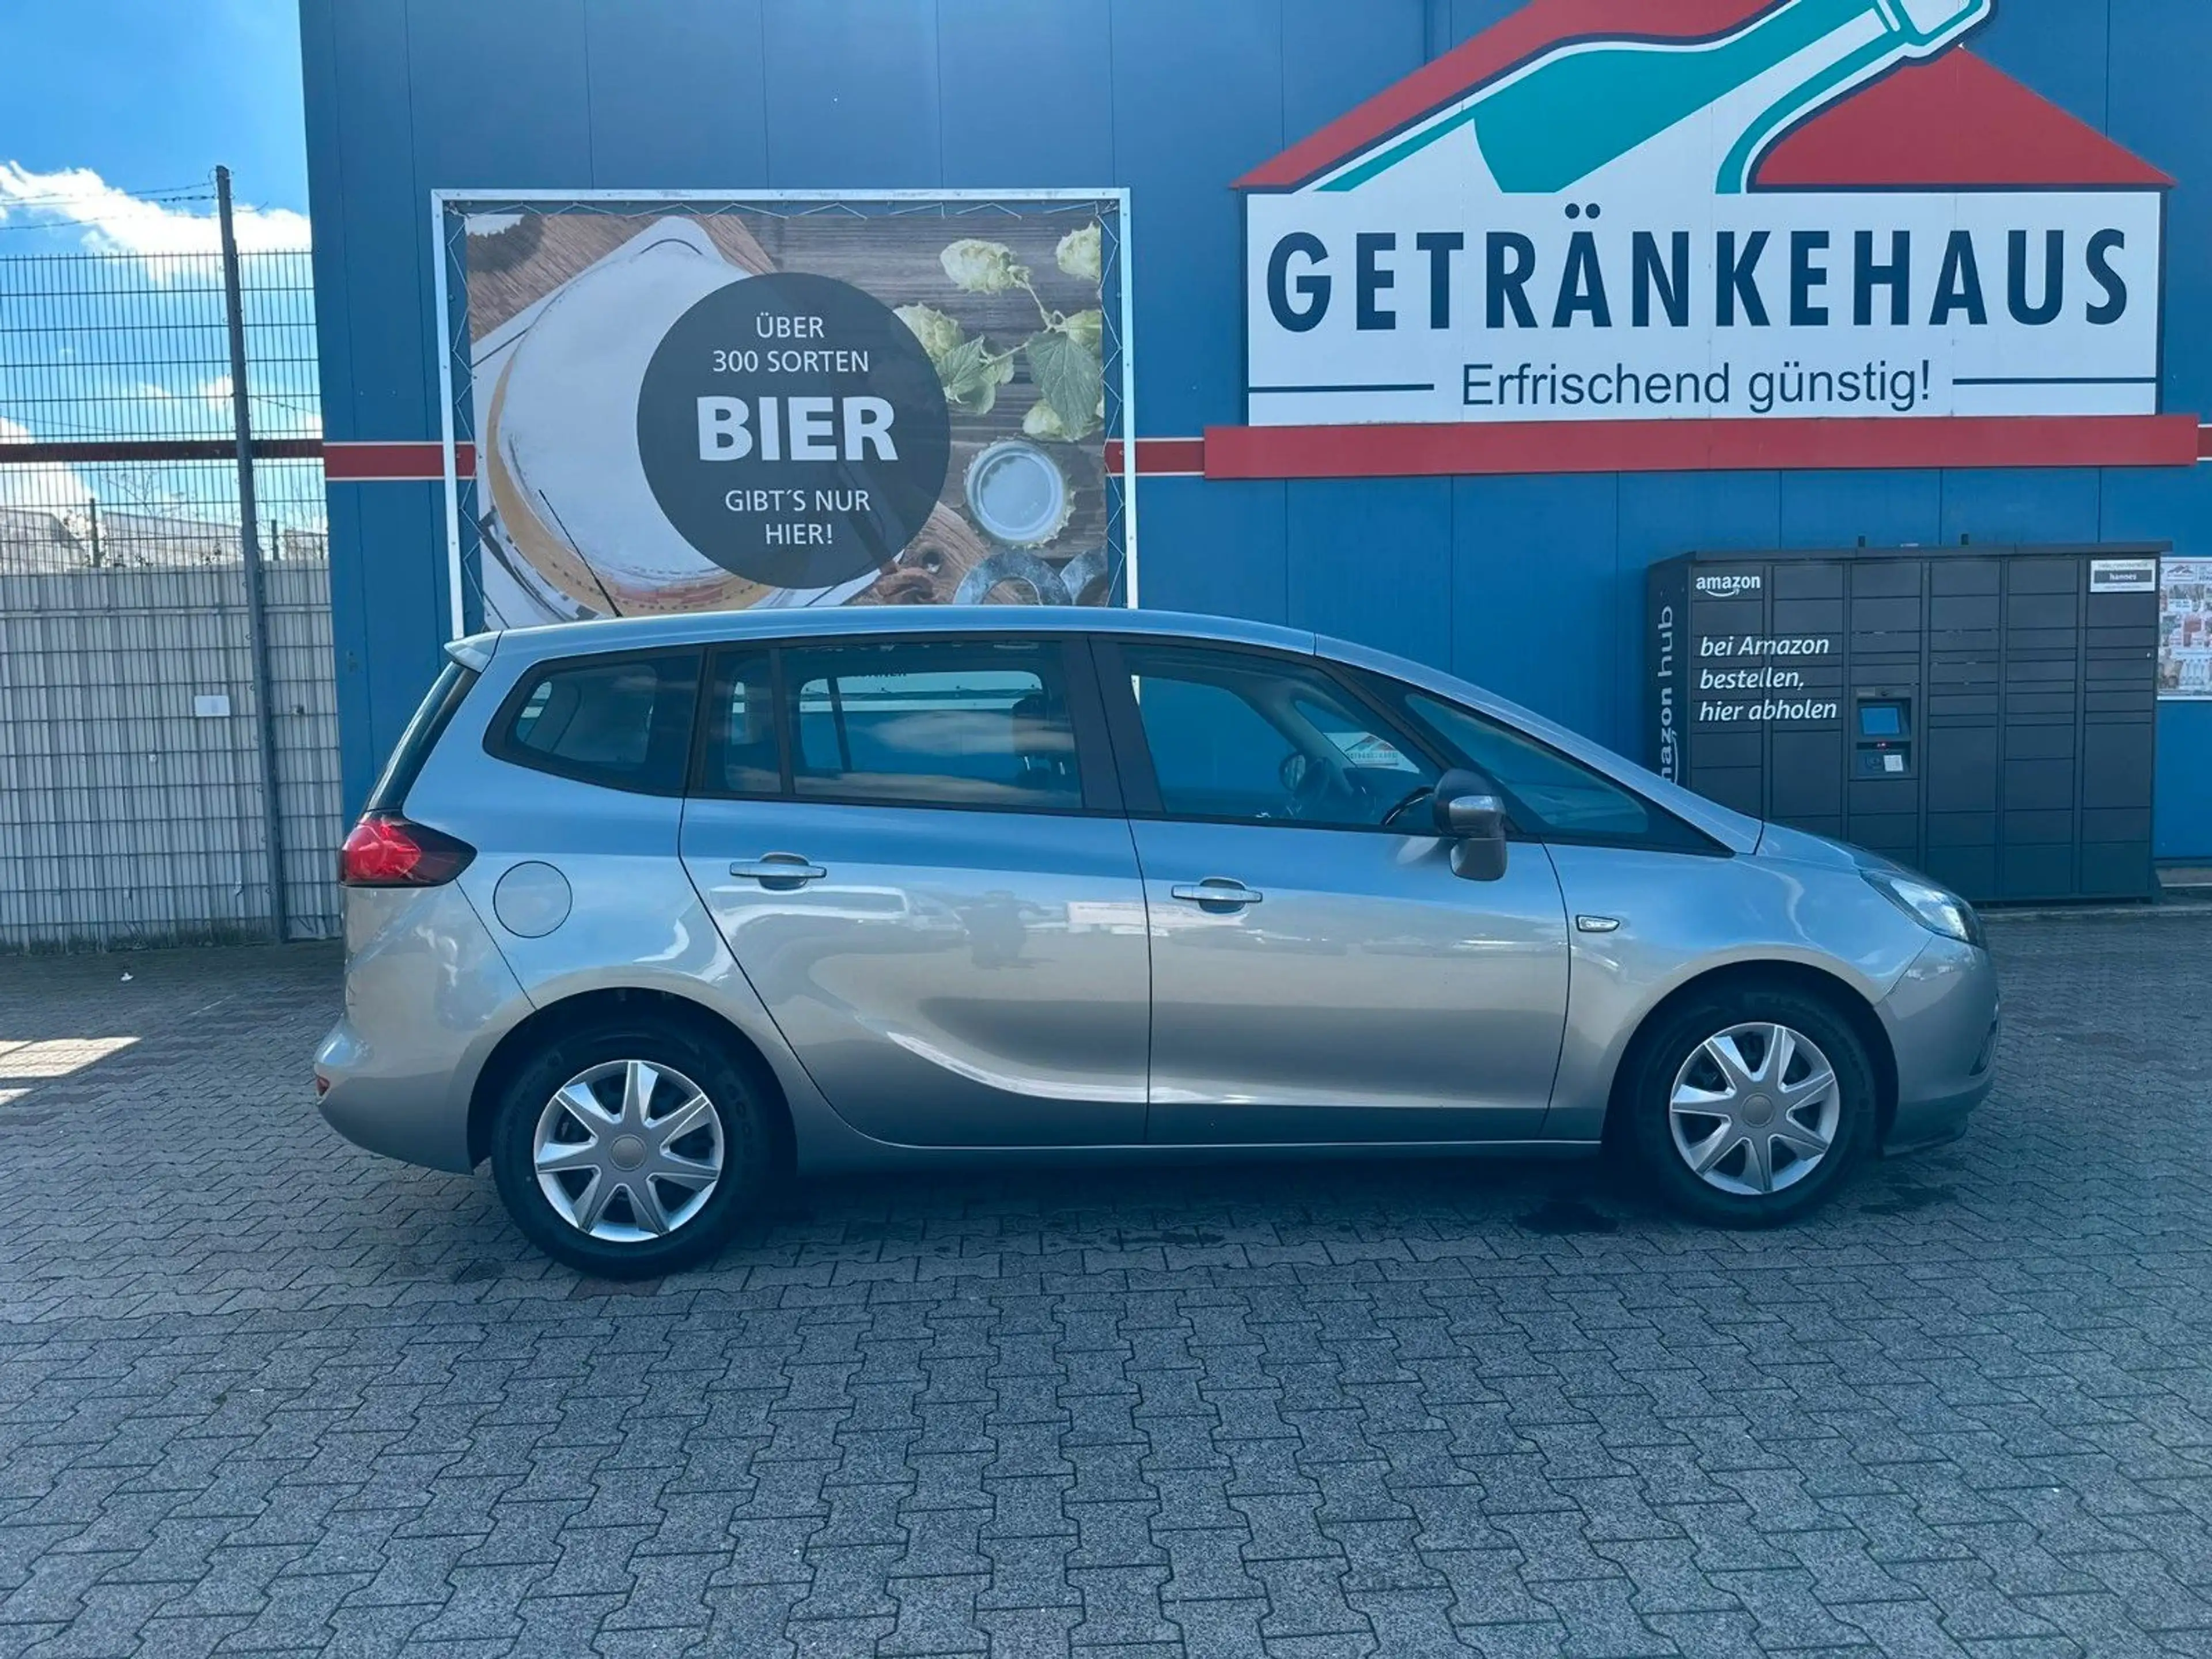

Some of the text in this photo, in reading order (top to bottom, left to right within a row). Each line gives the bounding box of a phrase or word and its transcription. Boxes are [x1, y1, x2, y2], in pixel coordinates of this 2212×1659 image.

[1267, 203, 2127, 332] GETRÄNKEHAUS
[757, 311, 825, 338] ÜBER
[713, 350, 869, 372] 300 SORTEN
[1463, 359, 1930, 413] Erfrischend günstig!
[697, 396, 898, 461] BIER
[815, 490, 870, 512] NUR
[766, 524, 832, 544] HIER!
[1696, 576, 1761, 590] amazon
[1658, 606, 1672, 676] hub
[1700, 637, 1829, 656] bei Amazon
[1700, 667, 1804, 690] bestellen,
[1699, 699, 1837, 721] hier abholen
